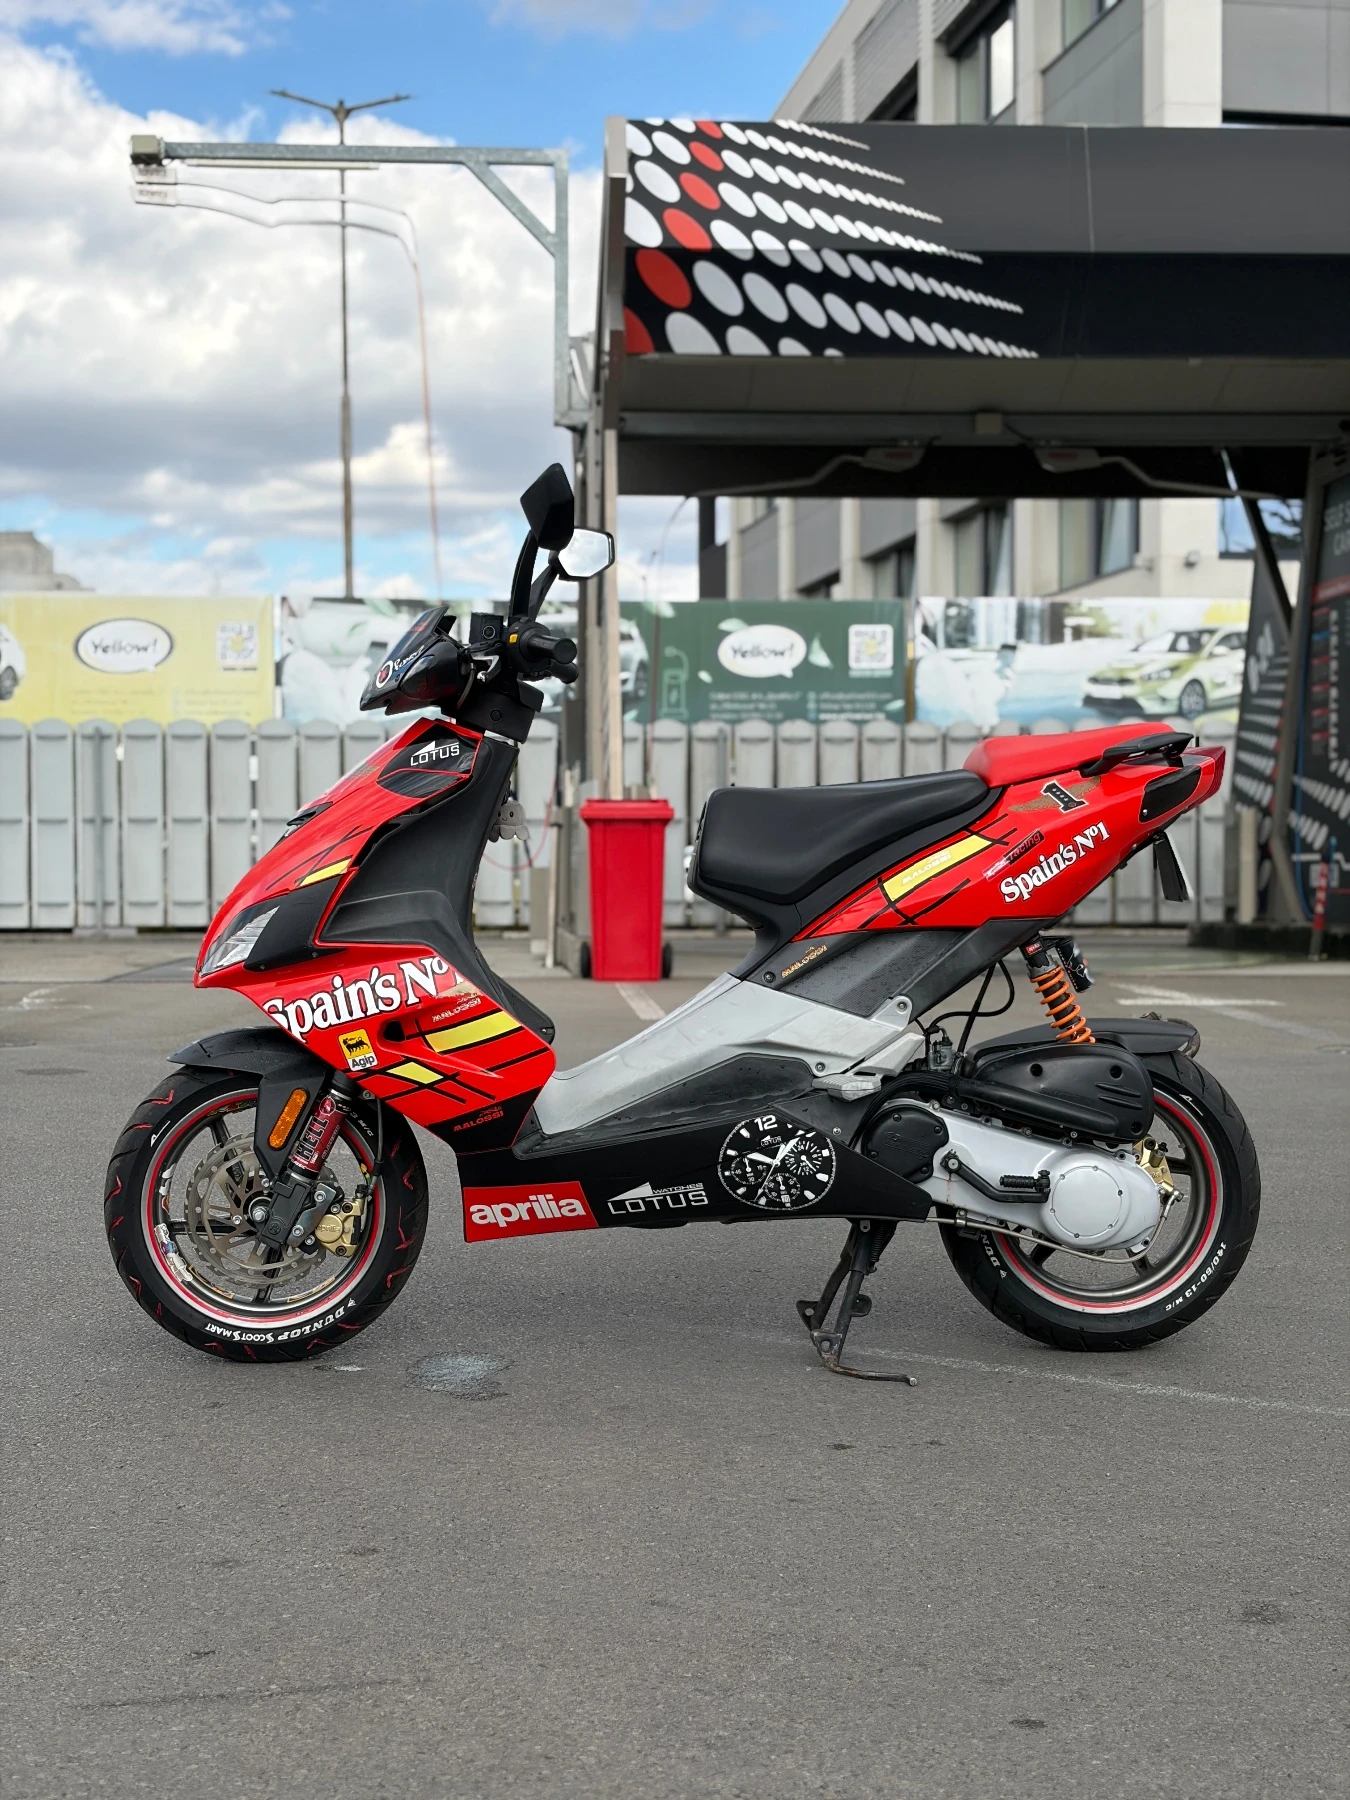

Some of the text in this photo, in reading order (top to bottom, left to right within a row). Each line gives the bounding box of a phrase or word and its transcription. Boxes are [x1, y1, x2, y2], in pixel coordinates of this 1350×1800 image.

[91, 637, 158, 655] Yellow!
[731, 642, 794, 659] Yellow!
[410, 744, 460, 767] LOTUS
[1009, 832, 1042, 861] racing
[1000, 842, 1077, 903] Spain's
[262, 966, 402, 1044] Spain's
[350, 1055, 375, 1069] Agip
[453, 1110, 504, 1132] MALOSSI
[754, 1114, 778, 1132] 12
[294, 1115, 330, 1163] HELL
[652, 1182, 704, 1194] WATCHES
[469, 1193, 587, 1228] aprilia
[607, 1190, 709, 1215] LOTUS
[277, 1306, 345, 1340] DUNLOP
